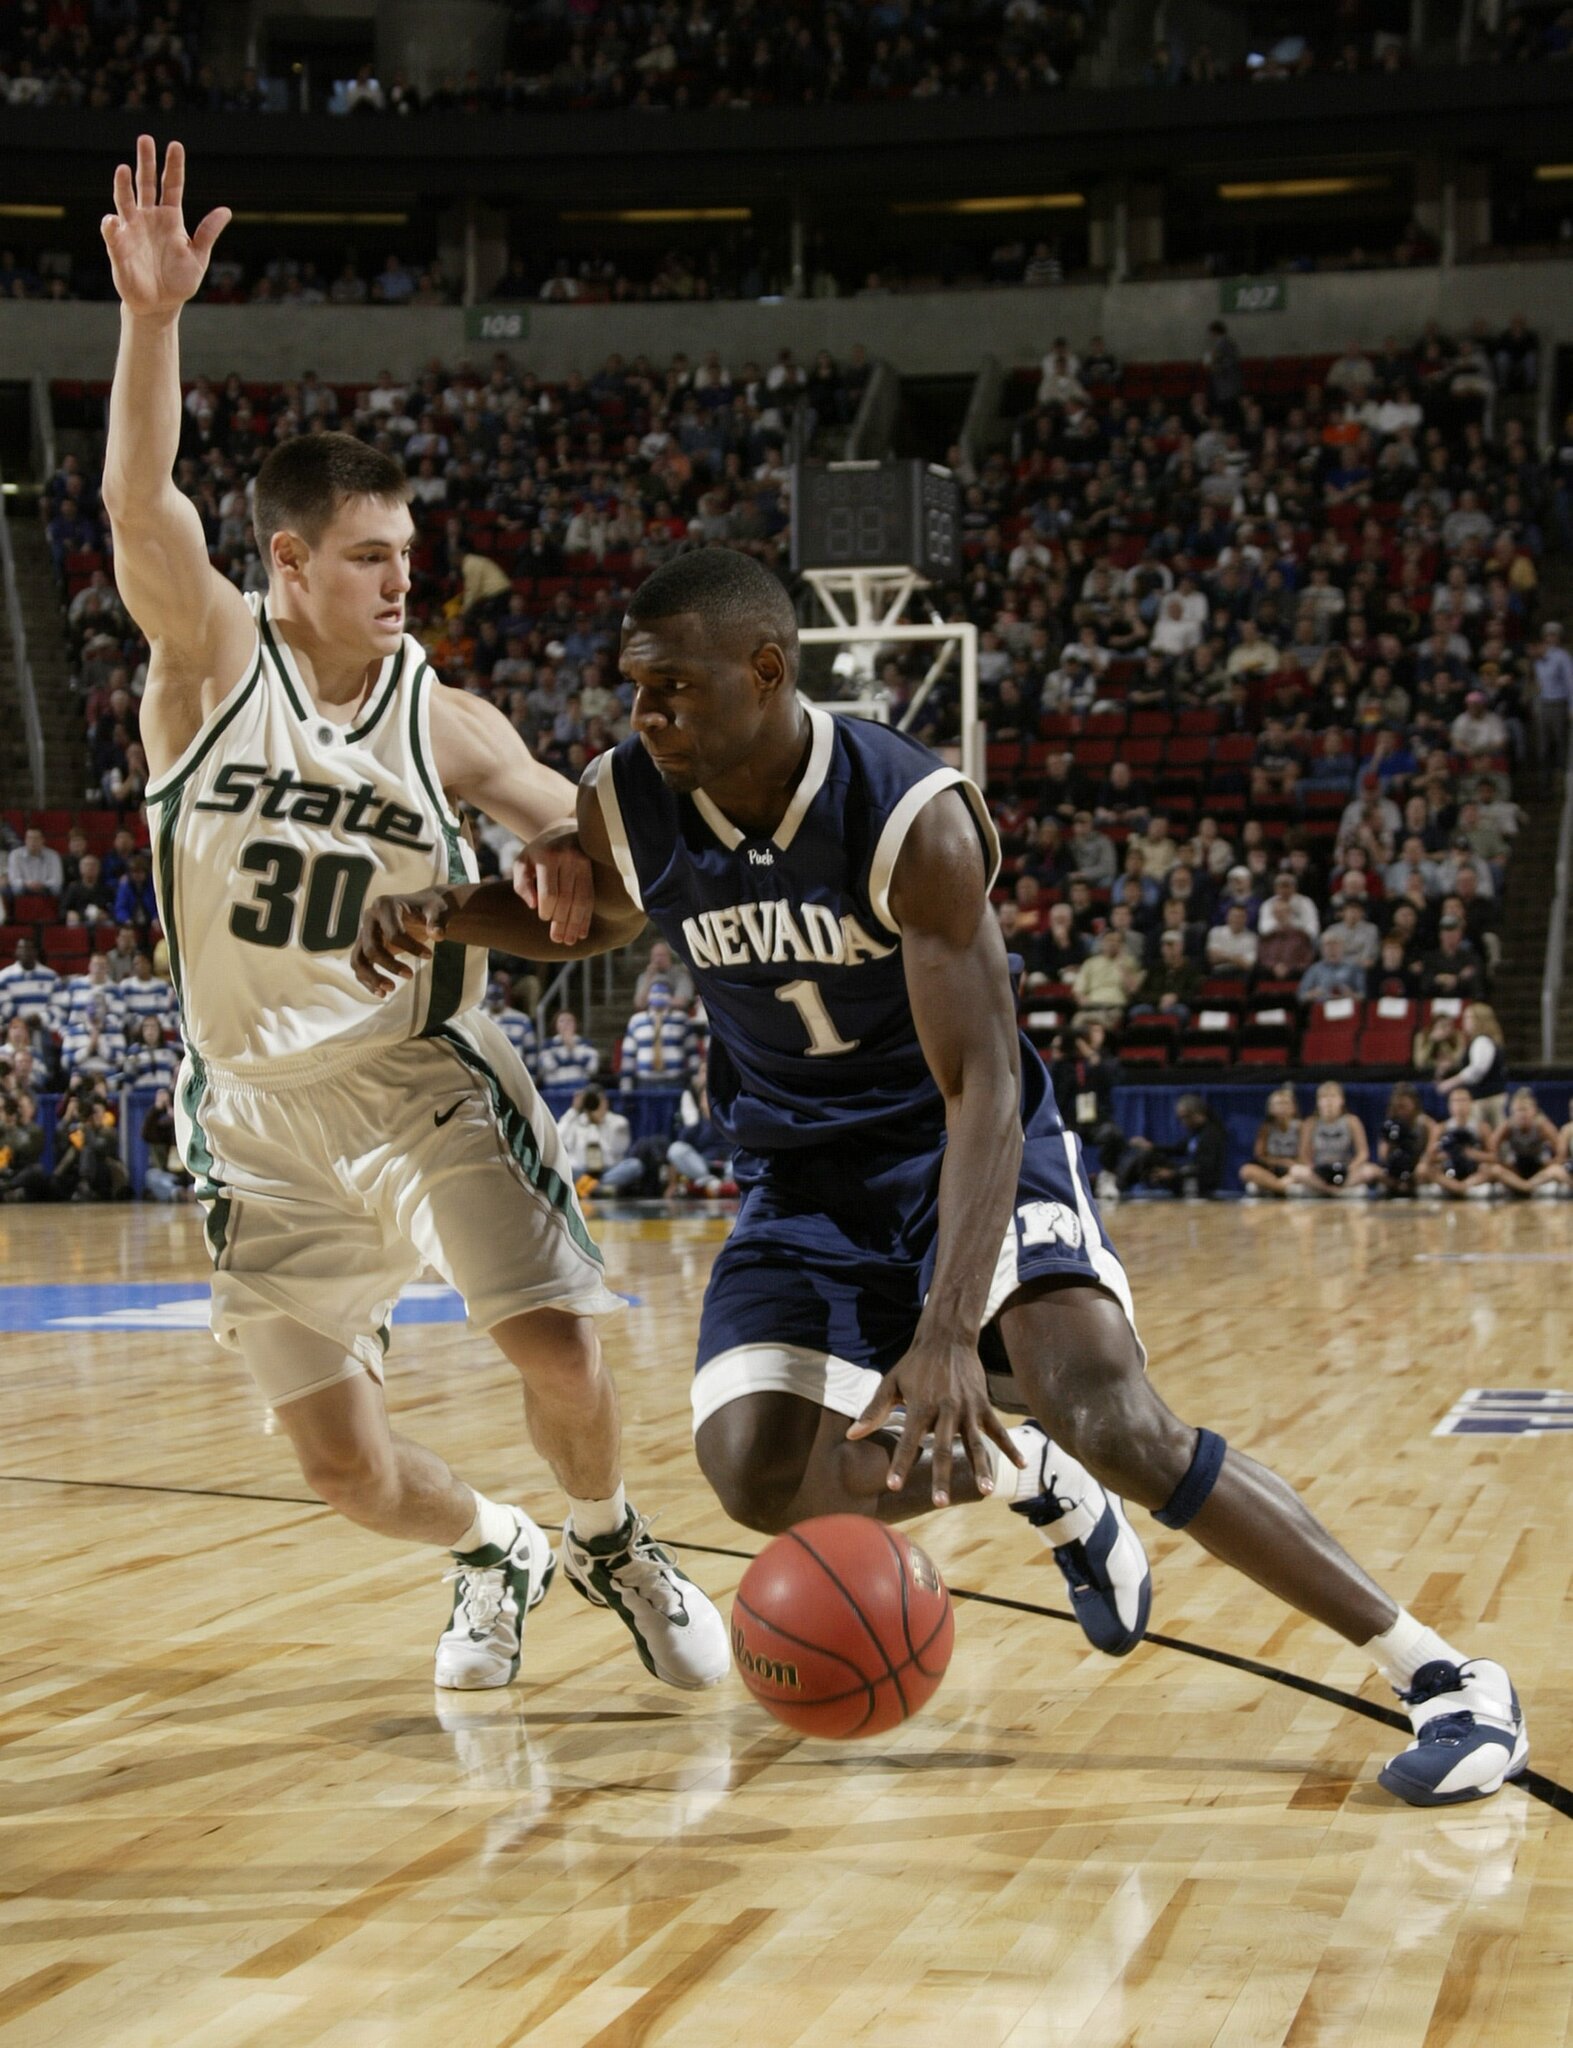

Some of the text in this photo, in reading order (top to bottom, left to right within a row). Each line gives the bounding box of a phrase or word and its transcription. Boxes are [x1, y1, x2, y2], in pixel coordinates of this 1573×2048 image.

[1236, 286, 1278, 308] 107
[195, 763, 434, 852] State
[229, 839, 376, 951] 30
[682, 898, 897, 969] NEVADA
[774, 979, 861, 1057] 1
